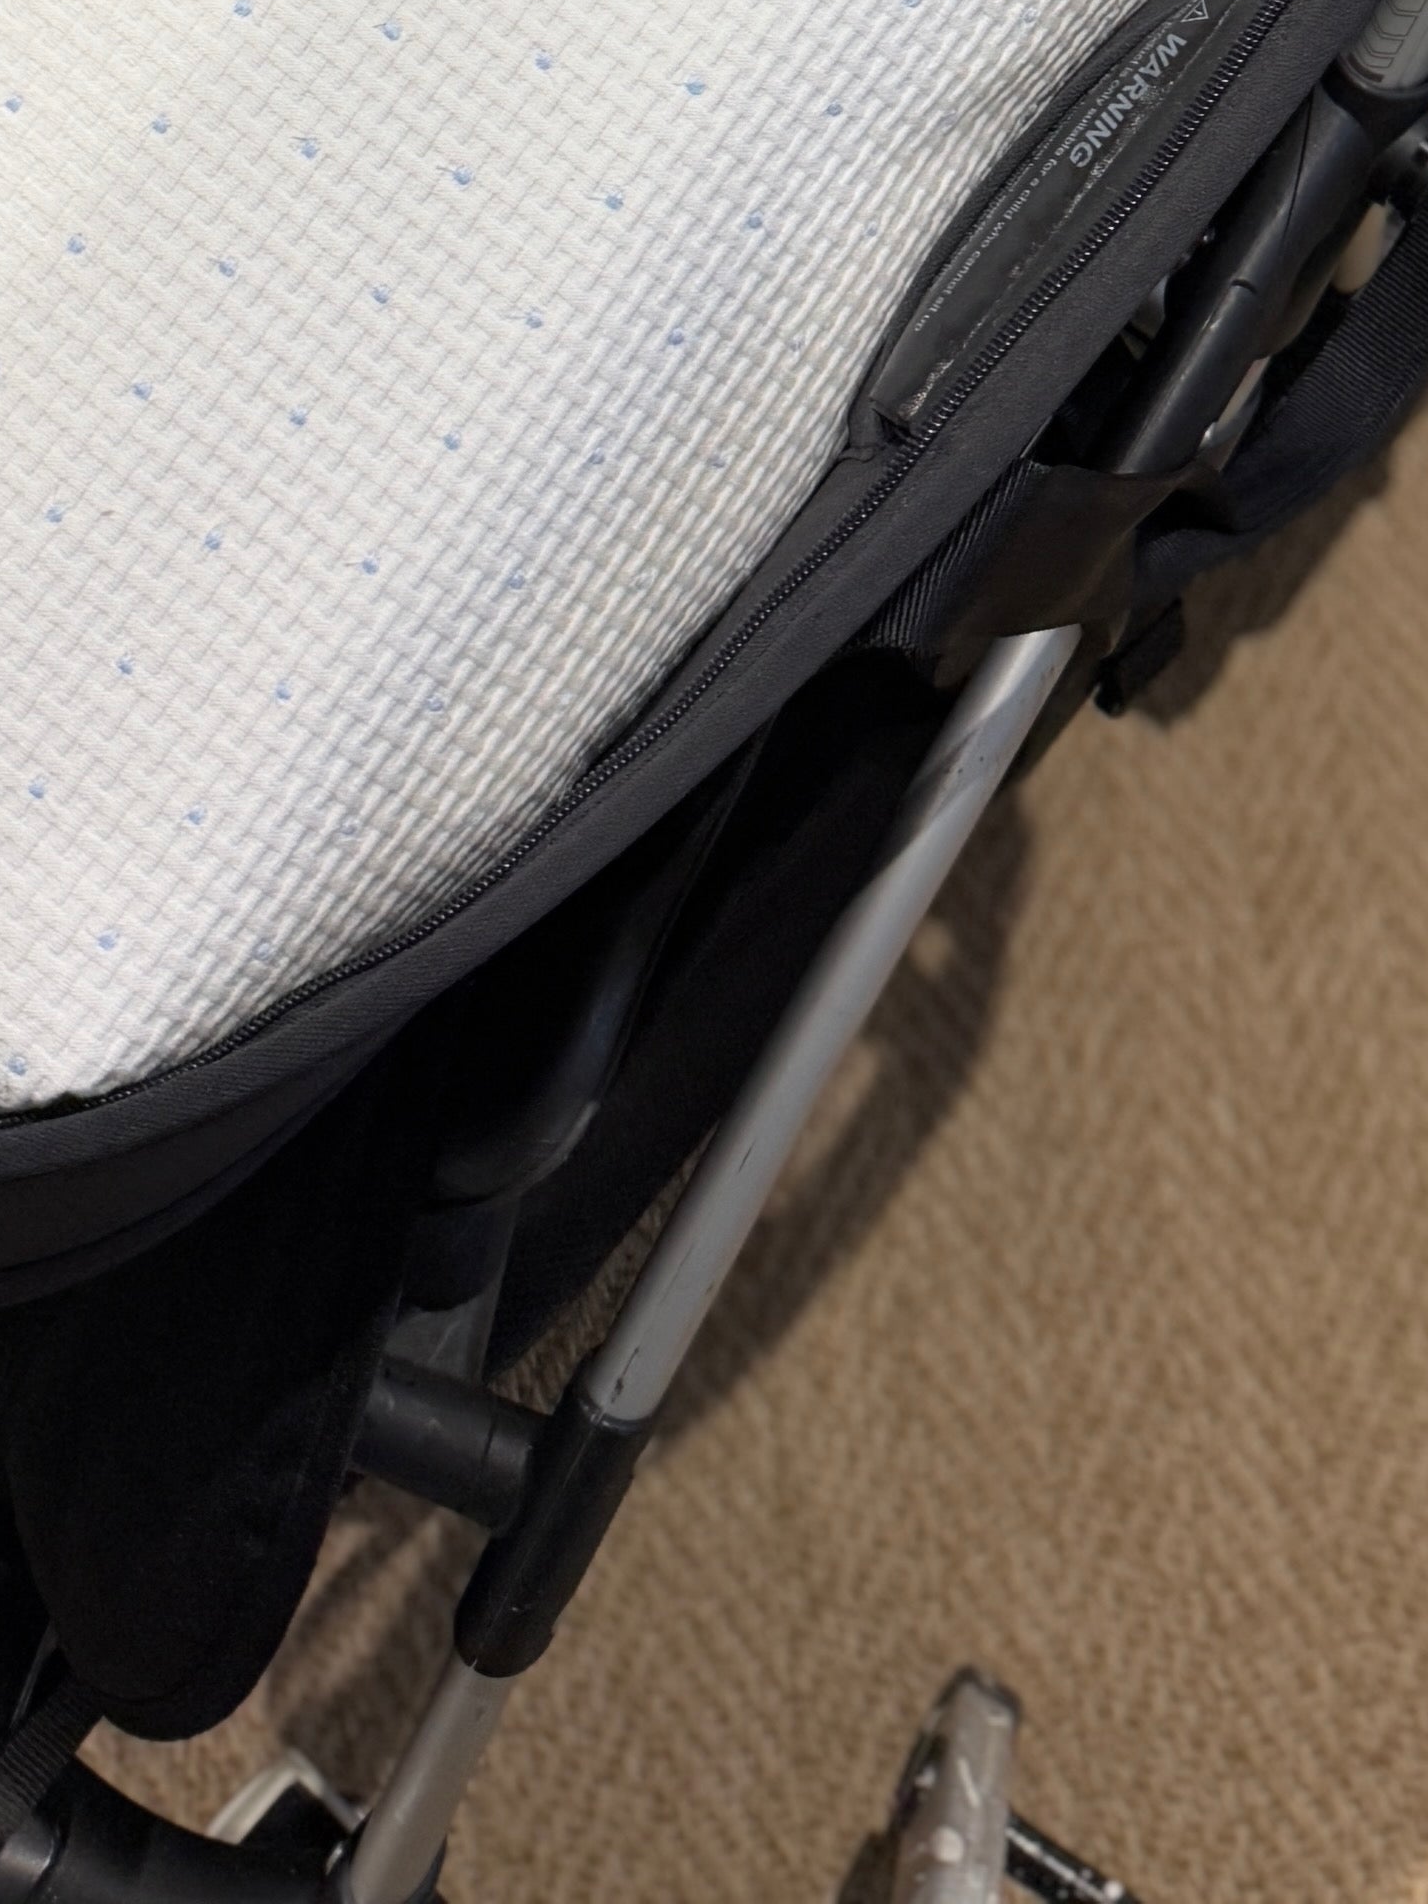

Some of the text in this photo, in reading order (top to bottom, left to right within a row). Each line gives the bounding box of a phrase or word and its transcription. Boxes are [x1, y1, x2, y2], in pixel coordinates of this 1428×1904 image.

[1068, 32, 1187, 168] WARNING
[1094, 78, 1120, 107] only
[1053, 106, 1097, 156] suitable
[1039, 157, 1058, 177] for
[1002, 188, 1031, 220] child
[979, 220, 1005, 248] who
[941, 249, 981, 295] cannot
[913, 313, 930, 332] up
